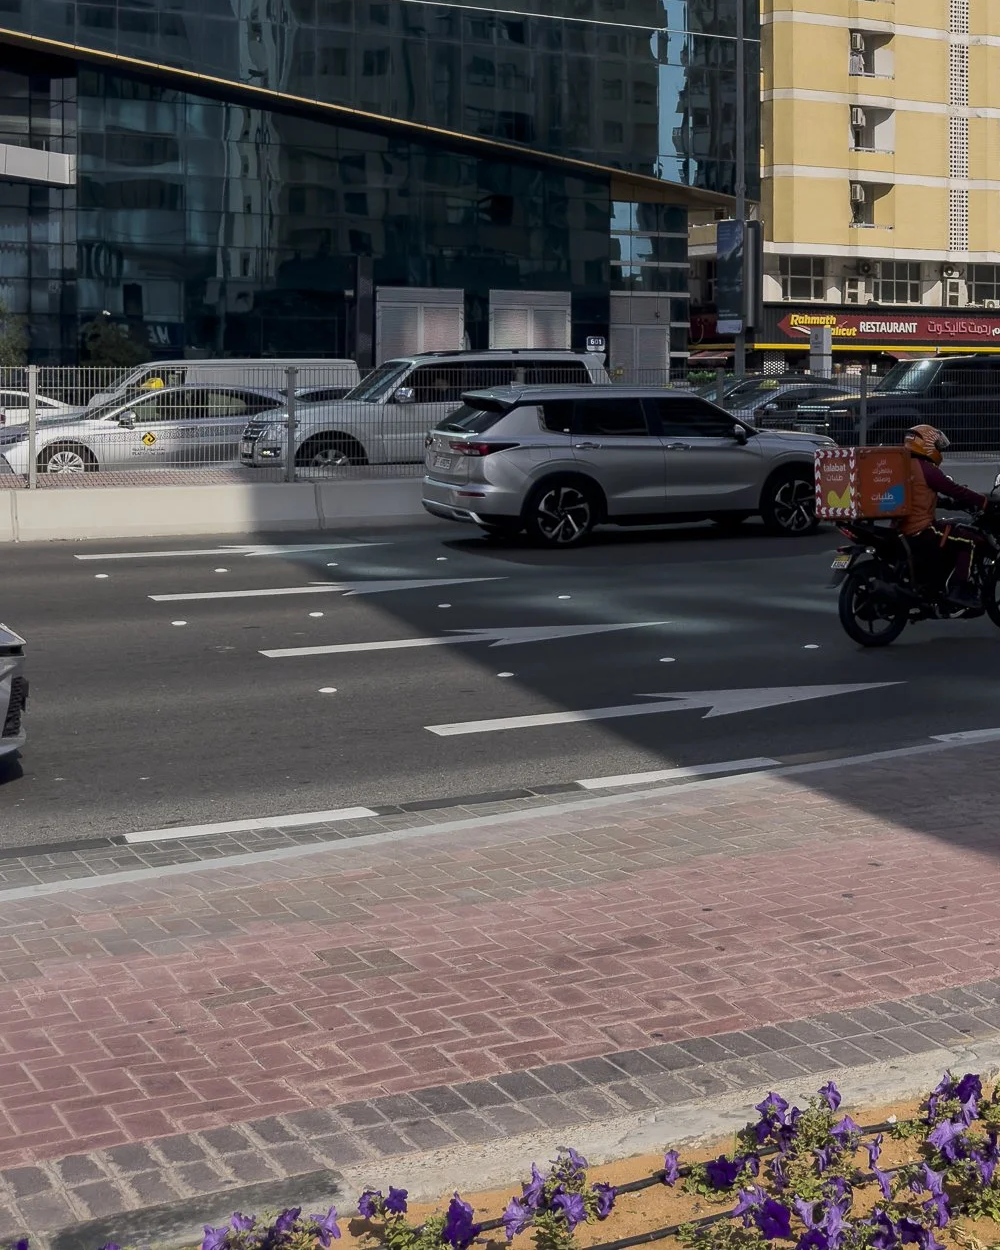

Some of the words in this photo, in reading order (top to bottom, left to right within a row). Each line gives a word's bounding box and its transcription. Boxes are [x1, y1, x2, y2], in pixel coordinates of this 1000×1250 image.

[790, 314, 836, 325] Rahmath
[824, 325, 857, 336] alicut
[860, 322, 917, 333] RESTAURANT
[928, 321, 968, 336] كاليكوت
[968, 322, 991, 336] رحمت
[823, 463, 846, 472] talabat
[826, 473, 843, 482] طلبات
[871, 492, 894, 502] طلبات
